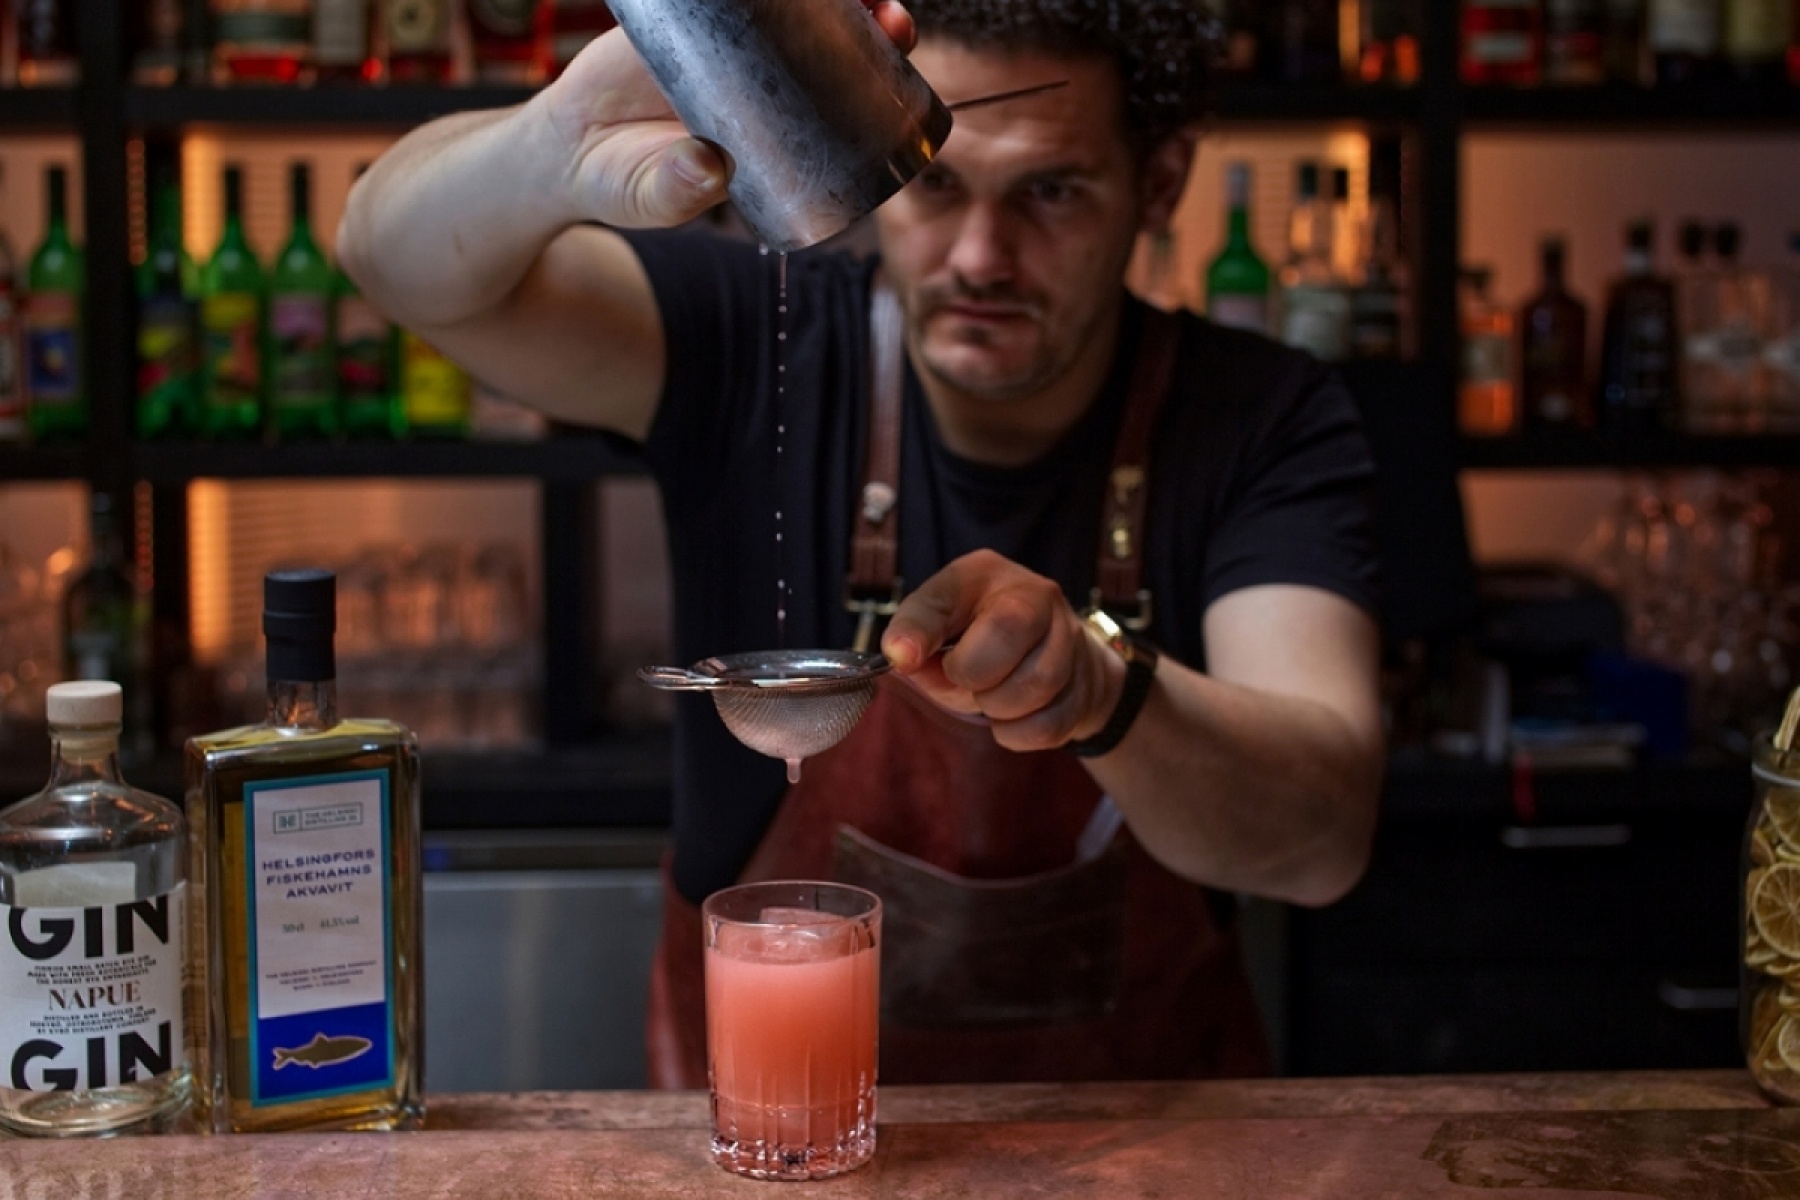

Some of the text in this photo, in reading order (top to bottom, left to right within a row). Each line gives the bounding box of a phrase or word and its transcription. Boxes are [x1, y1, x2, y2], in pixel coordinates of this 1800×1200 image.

[263, 848, 375, 871] HELSINGFORS
[267, 864, 372, 885] FISKEHAMNS
[286, 882, 353, 899] AKVAVIT
[9, 894, 169, 961] GIN
[49, 979, 142, 1010] NAPUE
[11, 1020, 172, 1091] GIN
